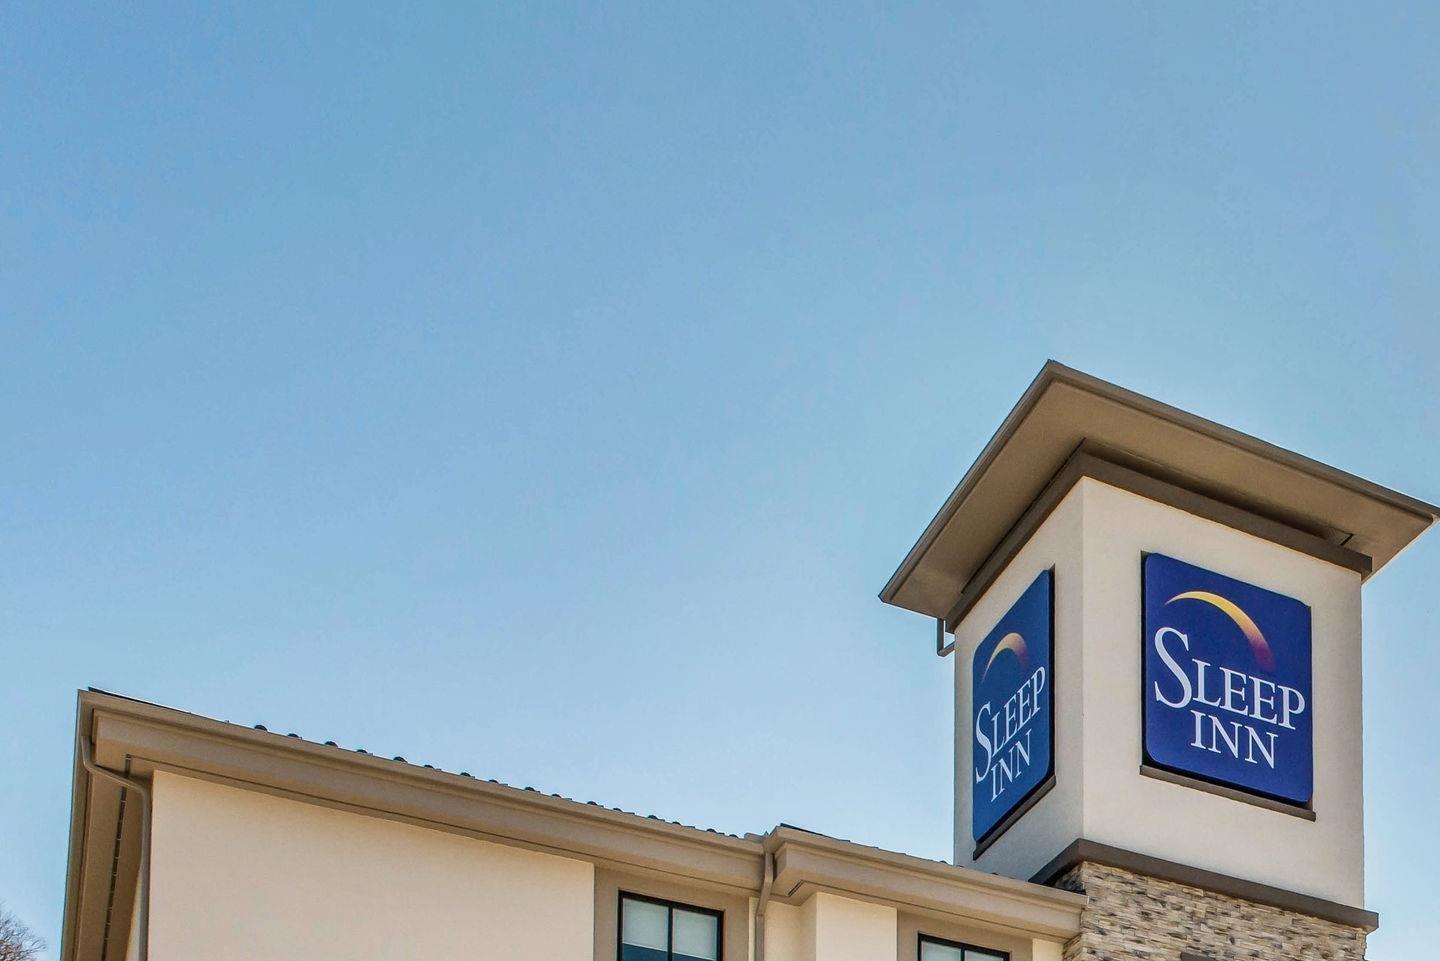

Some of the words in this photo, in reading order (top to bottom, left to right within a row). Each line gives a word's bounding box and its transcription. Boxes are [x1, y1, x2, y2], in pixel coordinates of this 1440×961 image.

[1154, 626, 1306, 730] SLEEP
[976, 666, 1046, 783] SLEEP
[990, 729, 1032, 802] INN
[1190, 709, 1279, 769] INN
